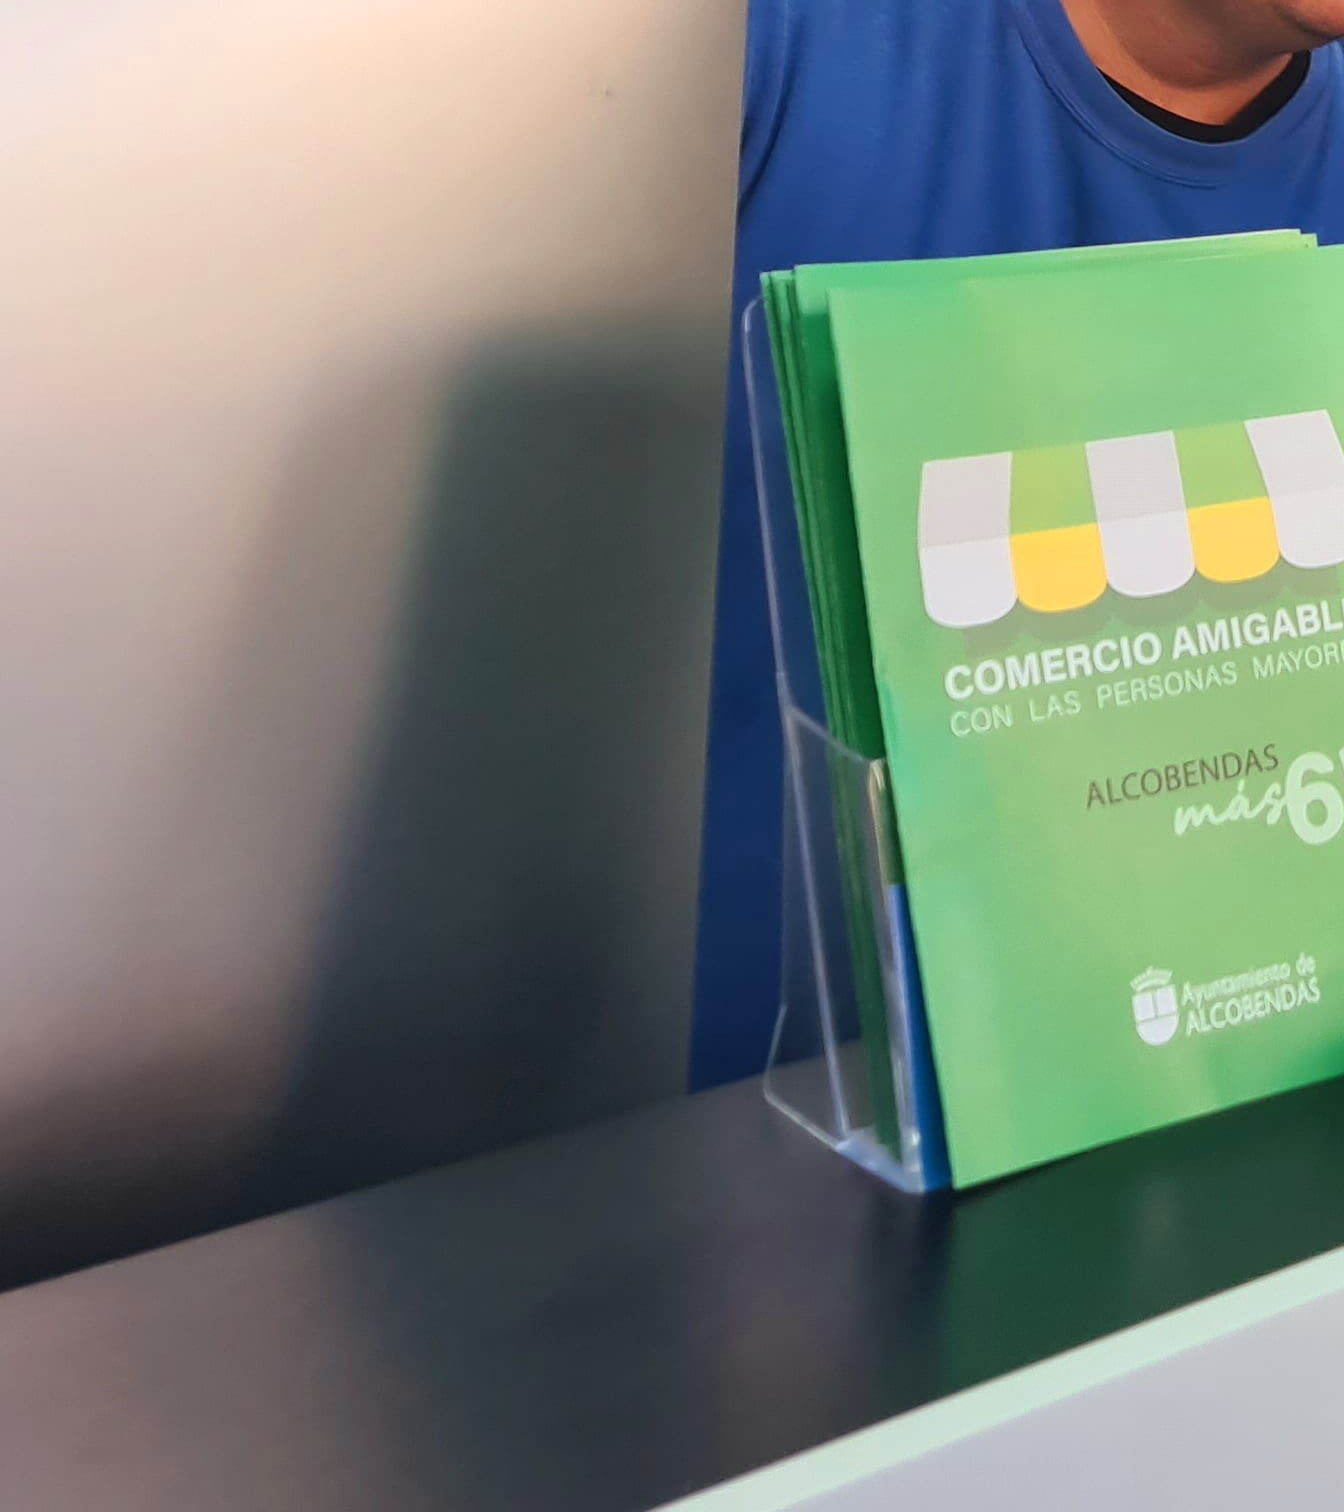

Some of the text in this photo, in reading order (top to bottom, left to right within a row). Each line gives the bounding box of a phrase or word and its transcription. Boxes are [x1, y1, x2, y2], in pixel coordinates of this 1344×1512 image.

[944, 632, 1164, 701] COMERCIO
[950, 703, 1013, 737] CON
[1029, 690, 1081, 723] LAS
[1097, 661, 1238, 710] PERSONAS
[1086, 743, 1279, 809] ALCOBENDAS
[1182, 952, 1316, 1009] Ayuntamiento de
[1185, 976, 1321, 1036] ALCOBENDAS
